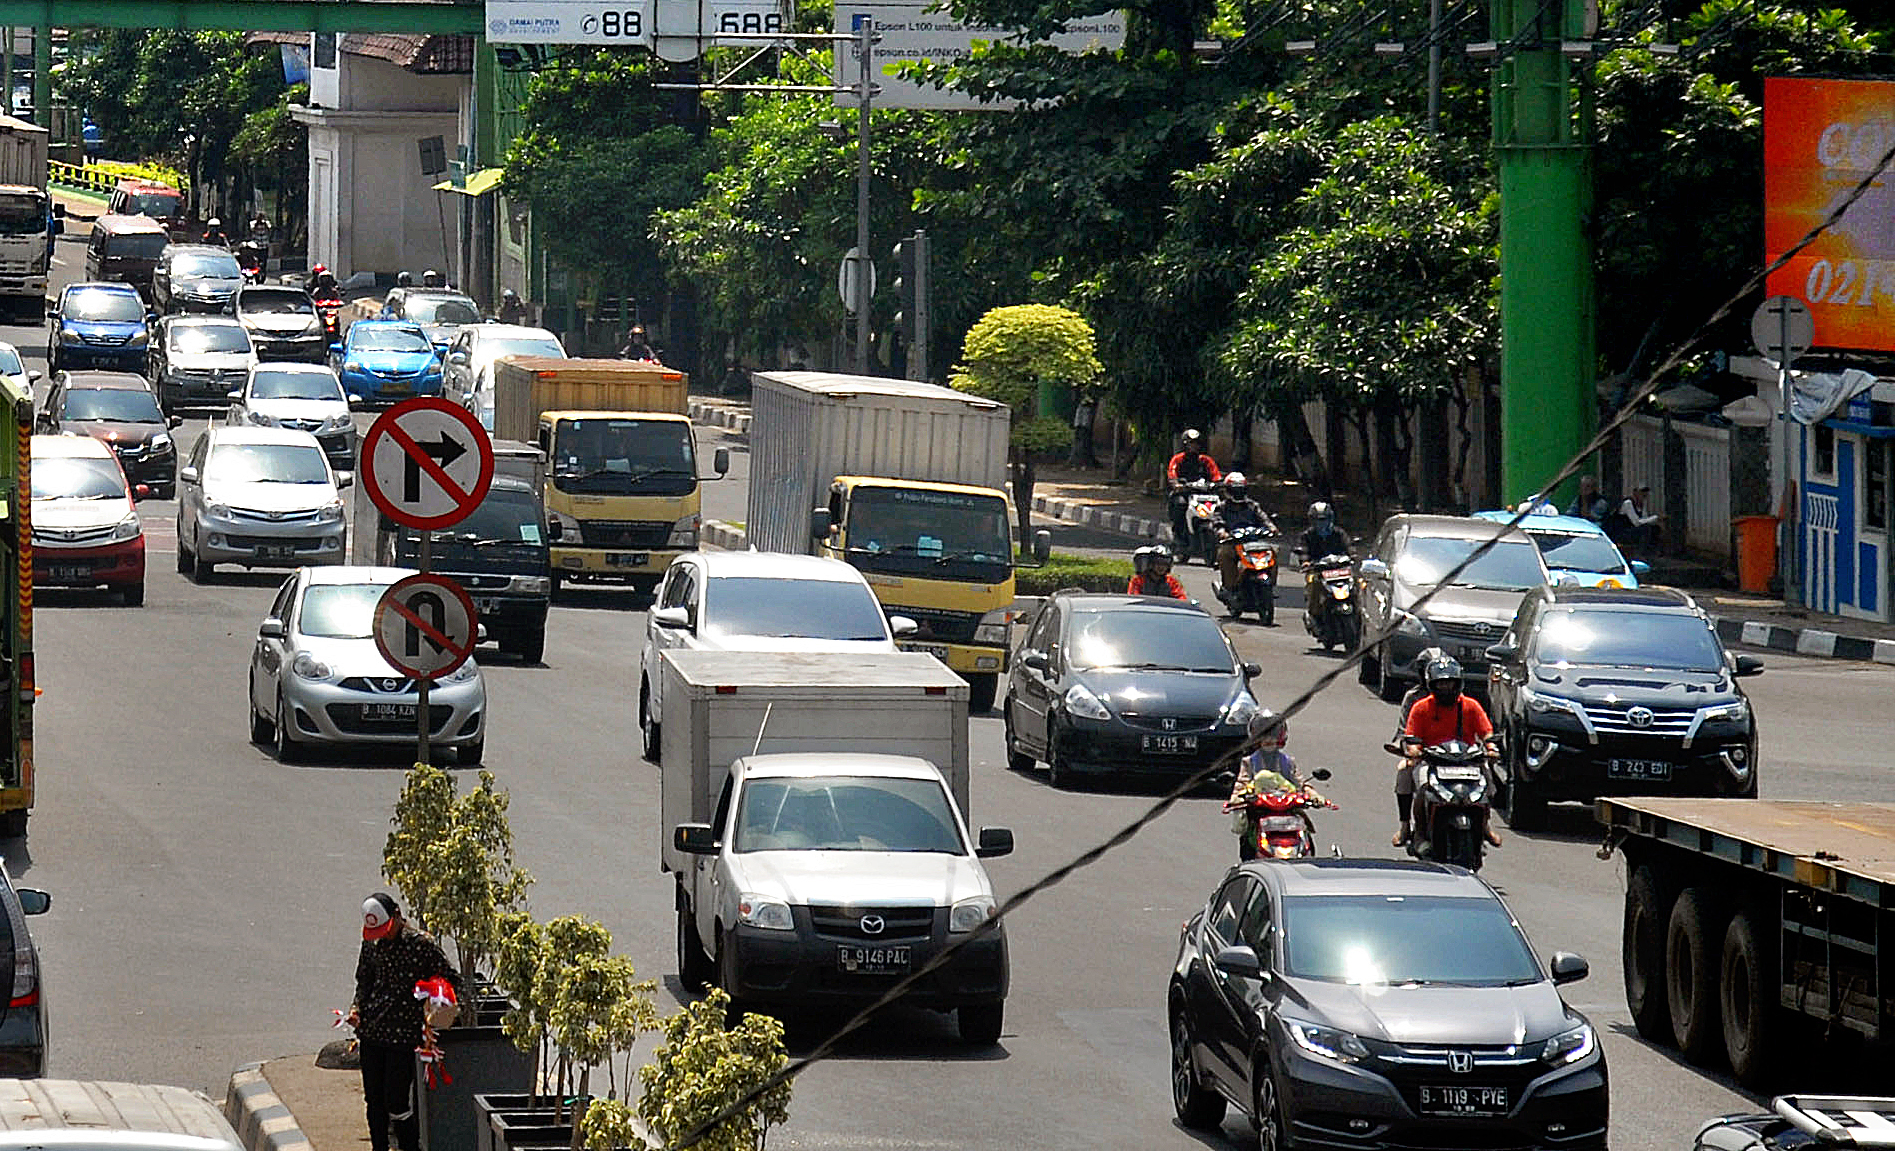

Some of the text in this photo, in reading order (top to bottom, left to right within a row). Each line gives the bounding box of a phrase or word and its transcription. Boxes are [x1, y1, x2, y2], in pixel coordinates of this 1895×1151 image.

[856, 948, 884, 964] 9146
[1421, 1086, 1506, 1105] B 1119 PYE
